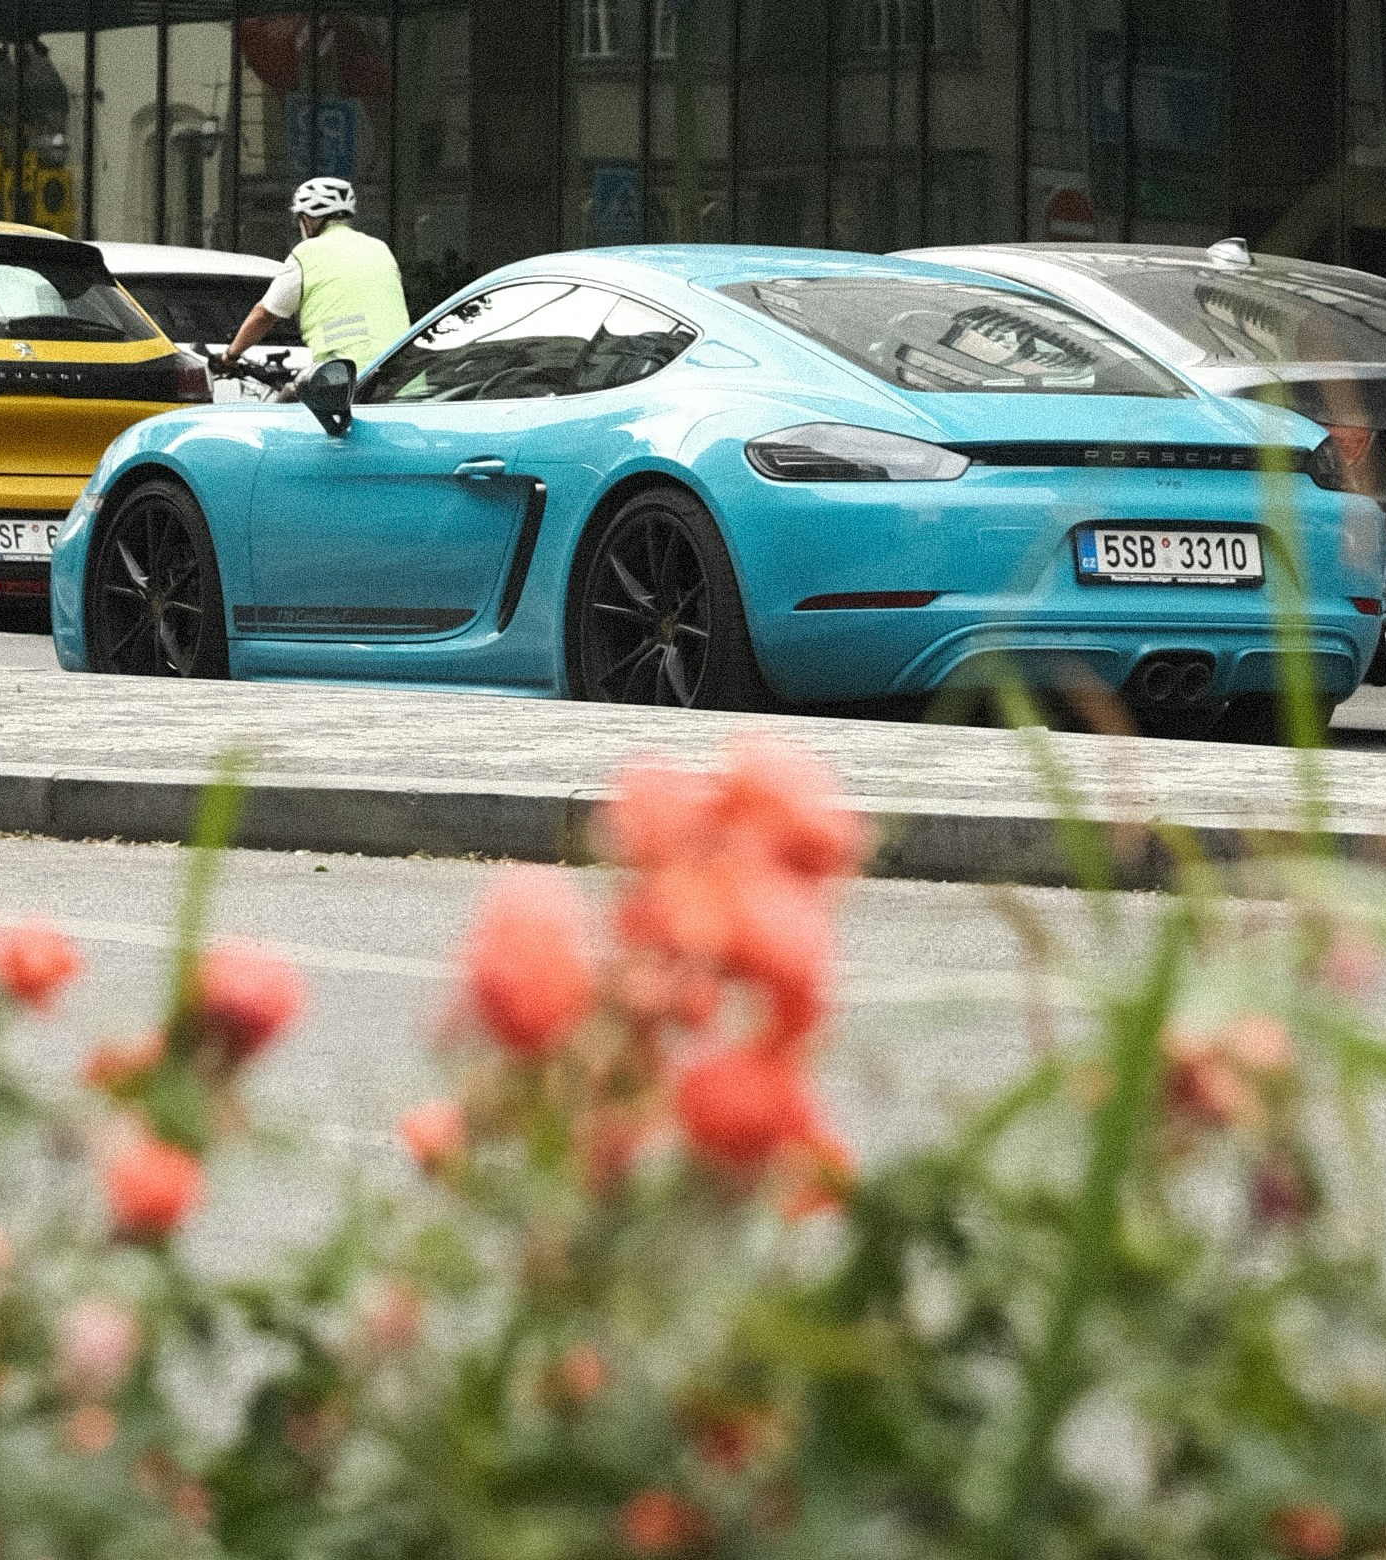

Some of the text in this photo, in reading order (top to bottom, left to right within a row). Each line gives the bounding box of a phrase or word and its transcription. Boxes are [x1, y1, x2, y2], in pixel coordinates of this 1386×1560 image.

[1084, 450, 1245, 464] PORSCHE
[1103, 534, 1248, 571] 5SB 3310
